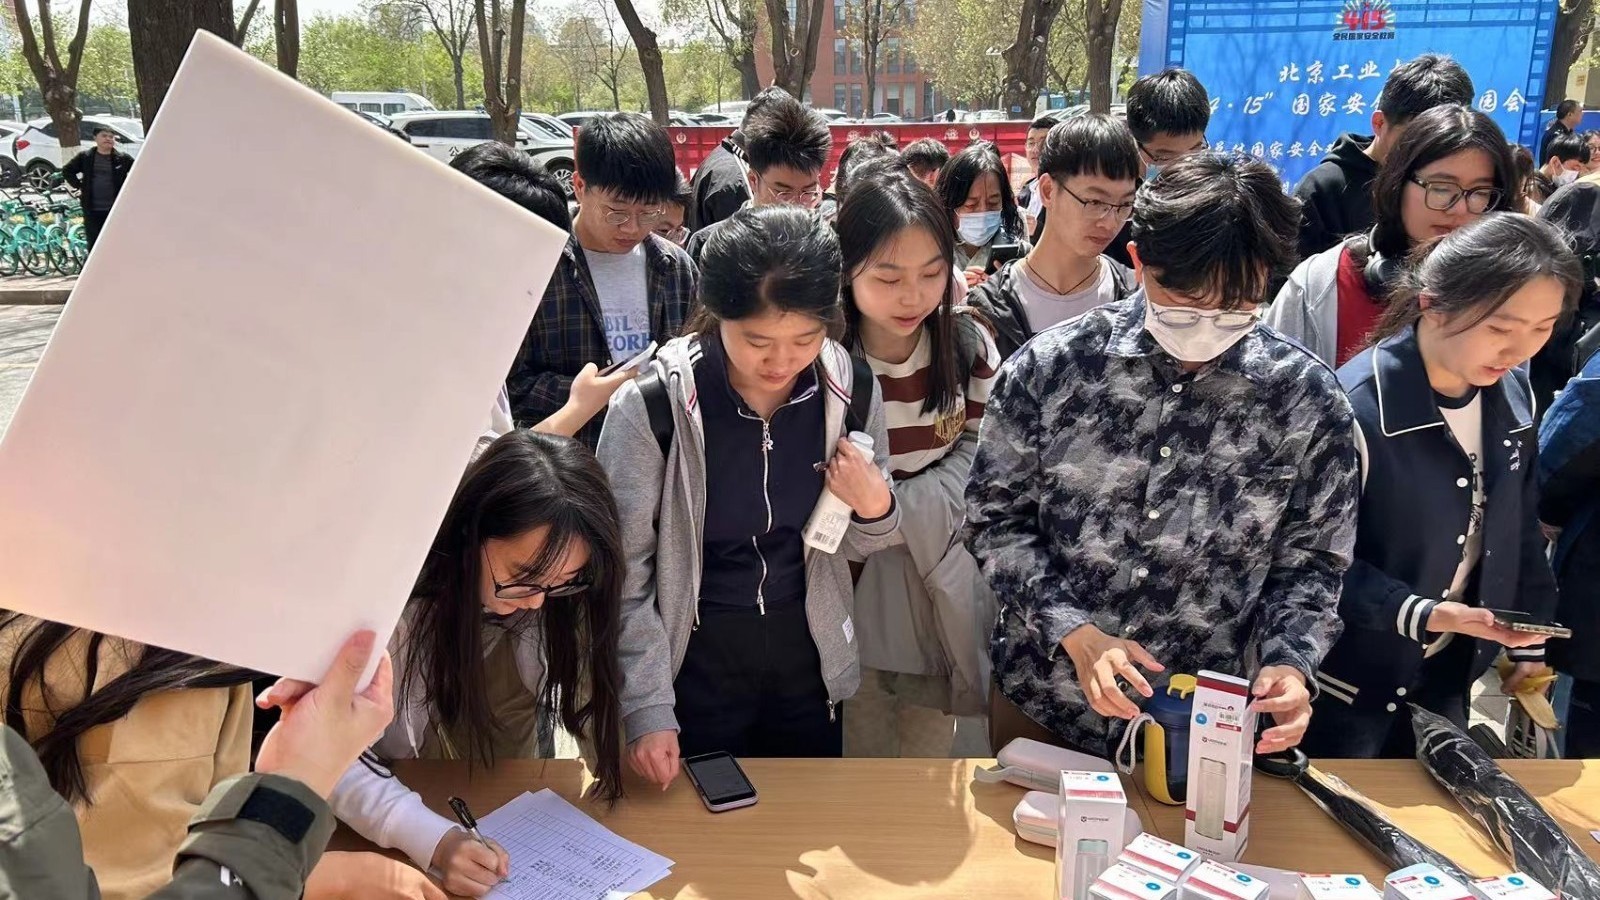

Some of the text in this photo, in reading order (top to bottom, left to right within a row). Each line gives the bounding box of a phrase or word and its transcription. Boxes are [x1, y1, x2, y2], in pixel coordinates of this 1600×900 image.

[1344, 10, 1388, 30] 415
[1333, 31, 1395, 41] 全民国家安全教育
